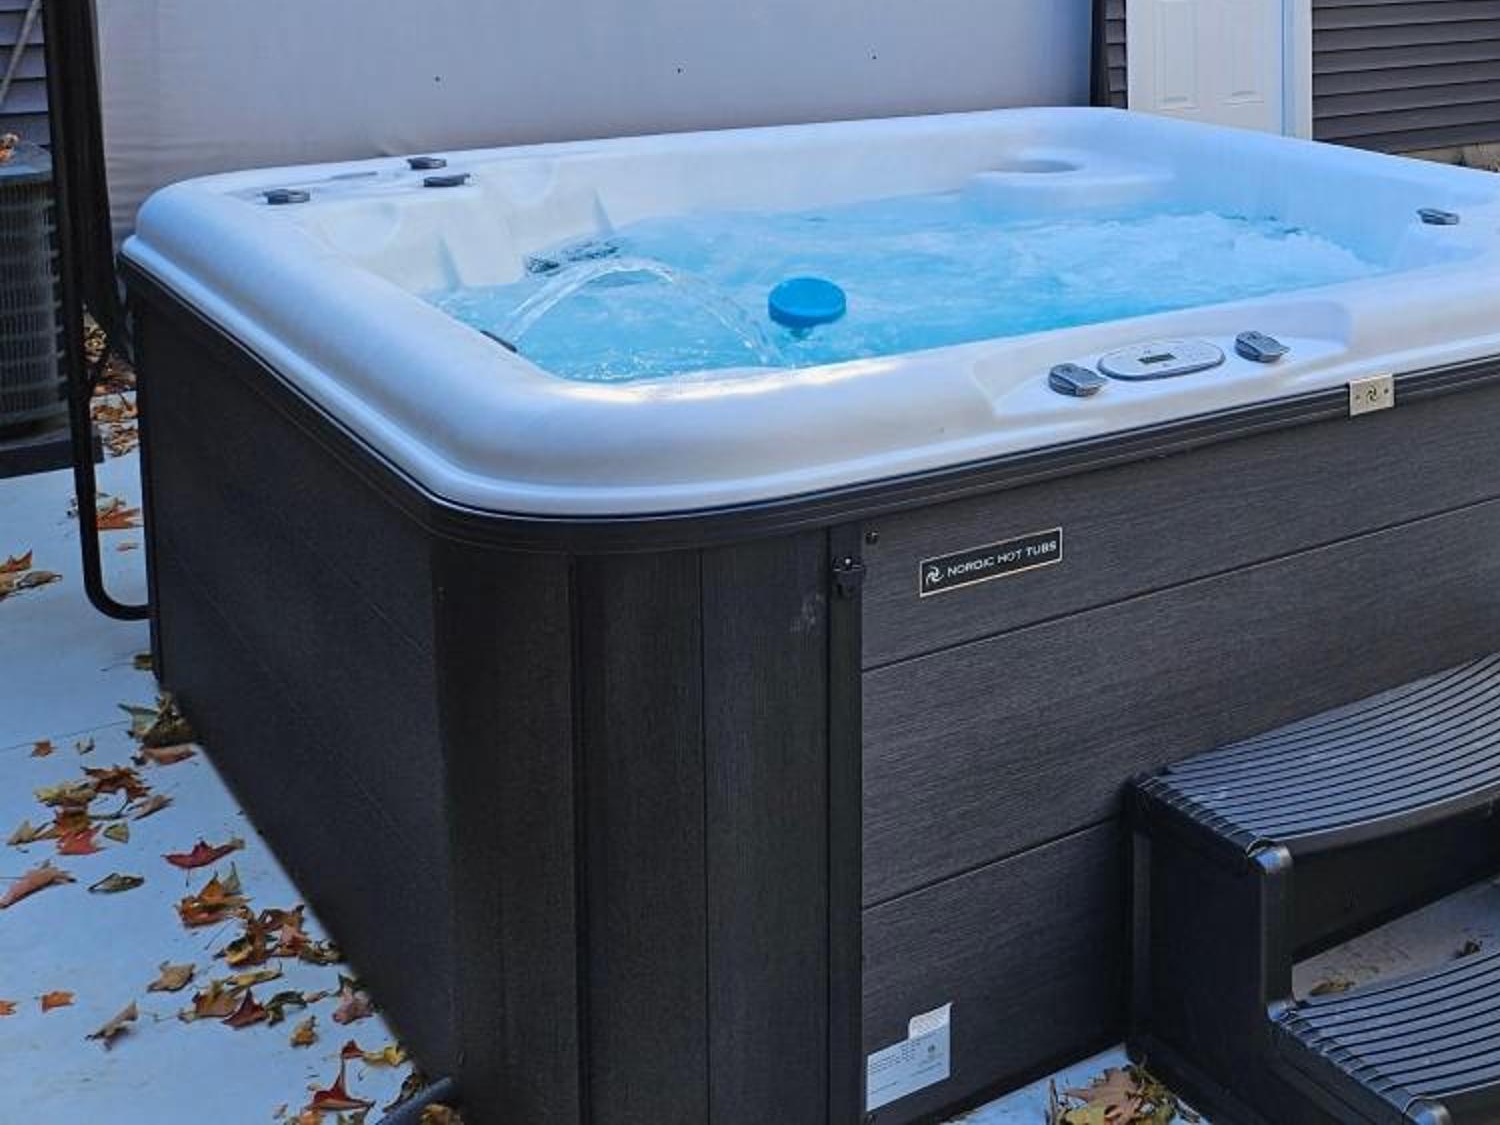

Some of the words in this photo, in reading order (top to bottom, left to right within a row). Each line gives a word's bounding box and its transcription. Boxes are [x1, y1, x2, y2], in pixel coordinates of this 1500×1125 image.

[947, 557, 994, 577] NORDIC
[998, 549, 1022, 563] HOT
[1025, 540, 1056, 557] TUBS
